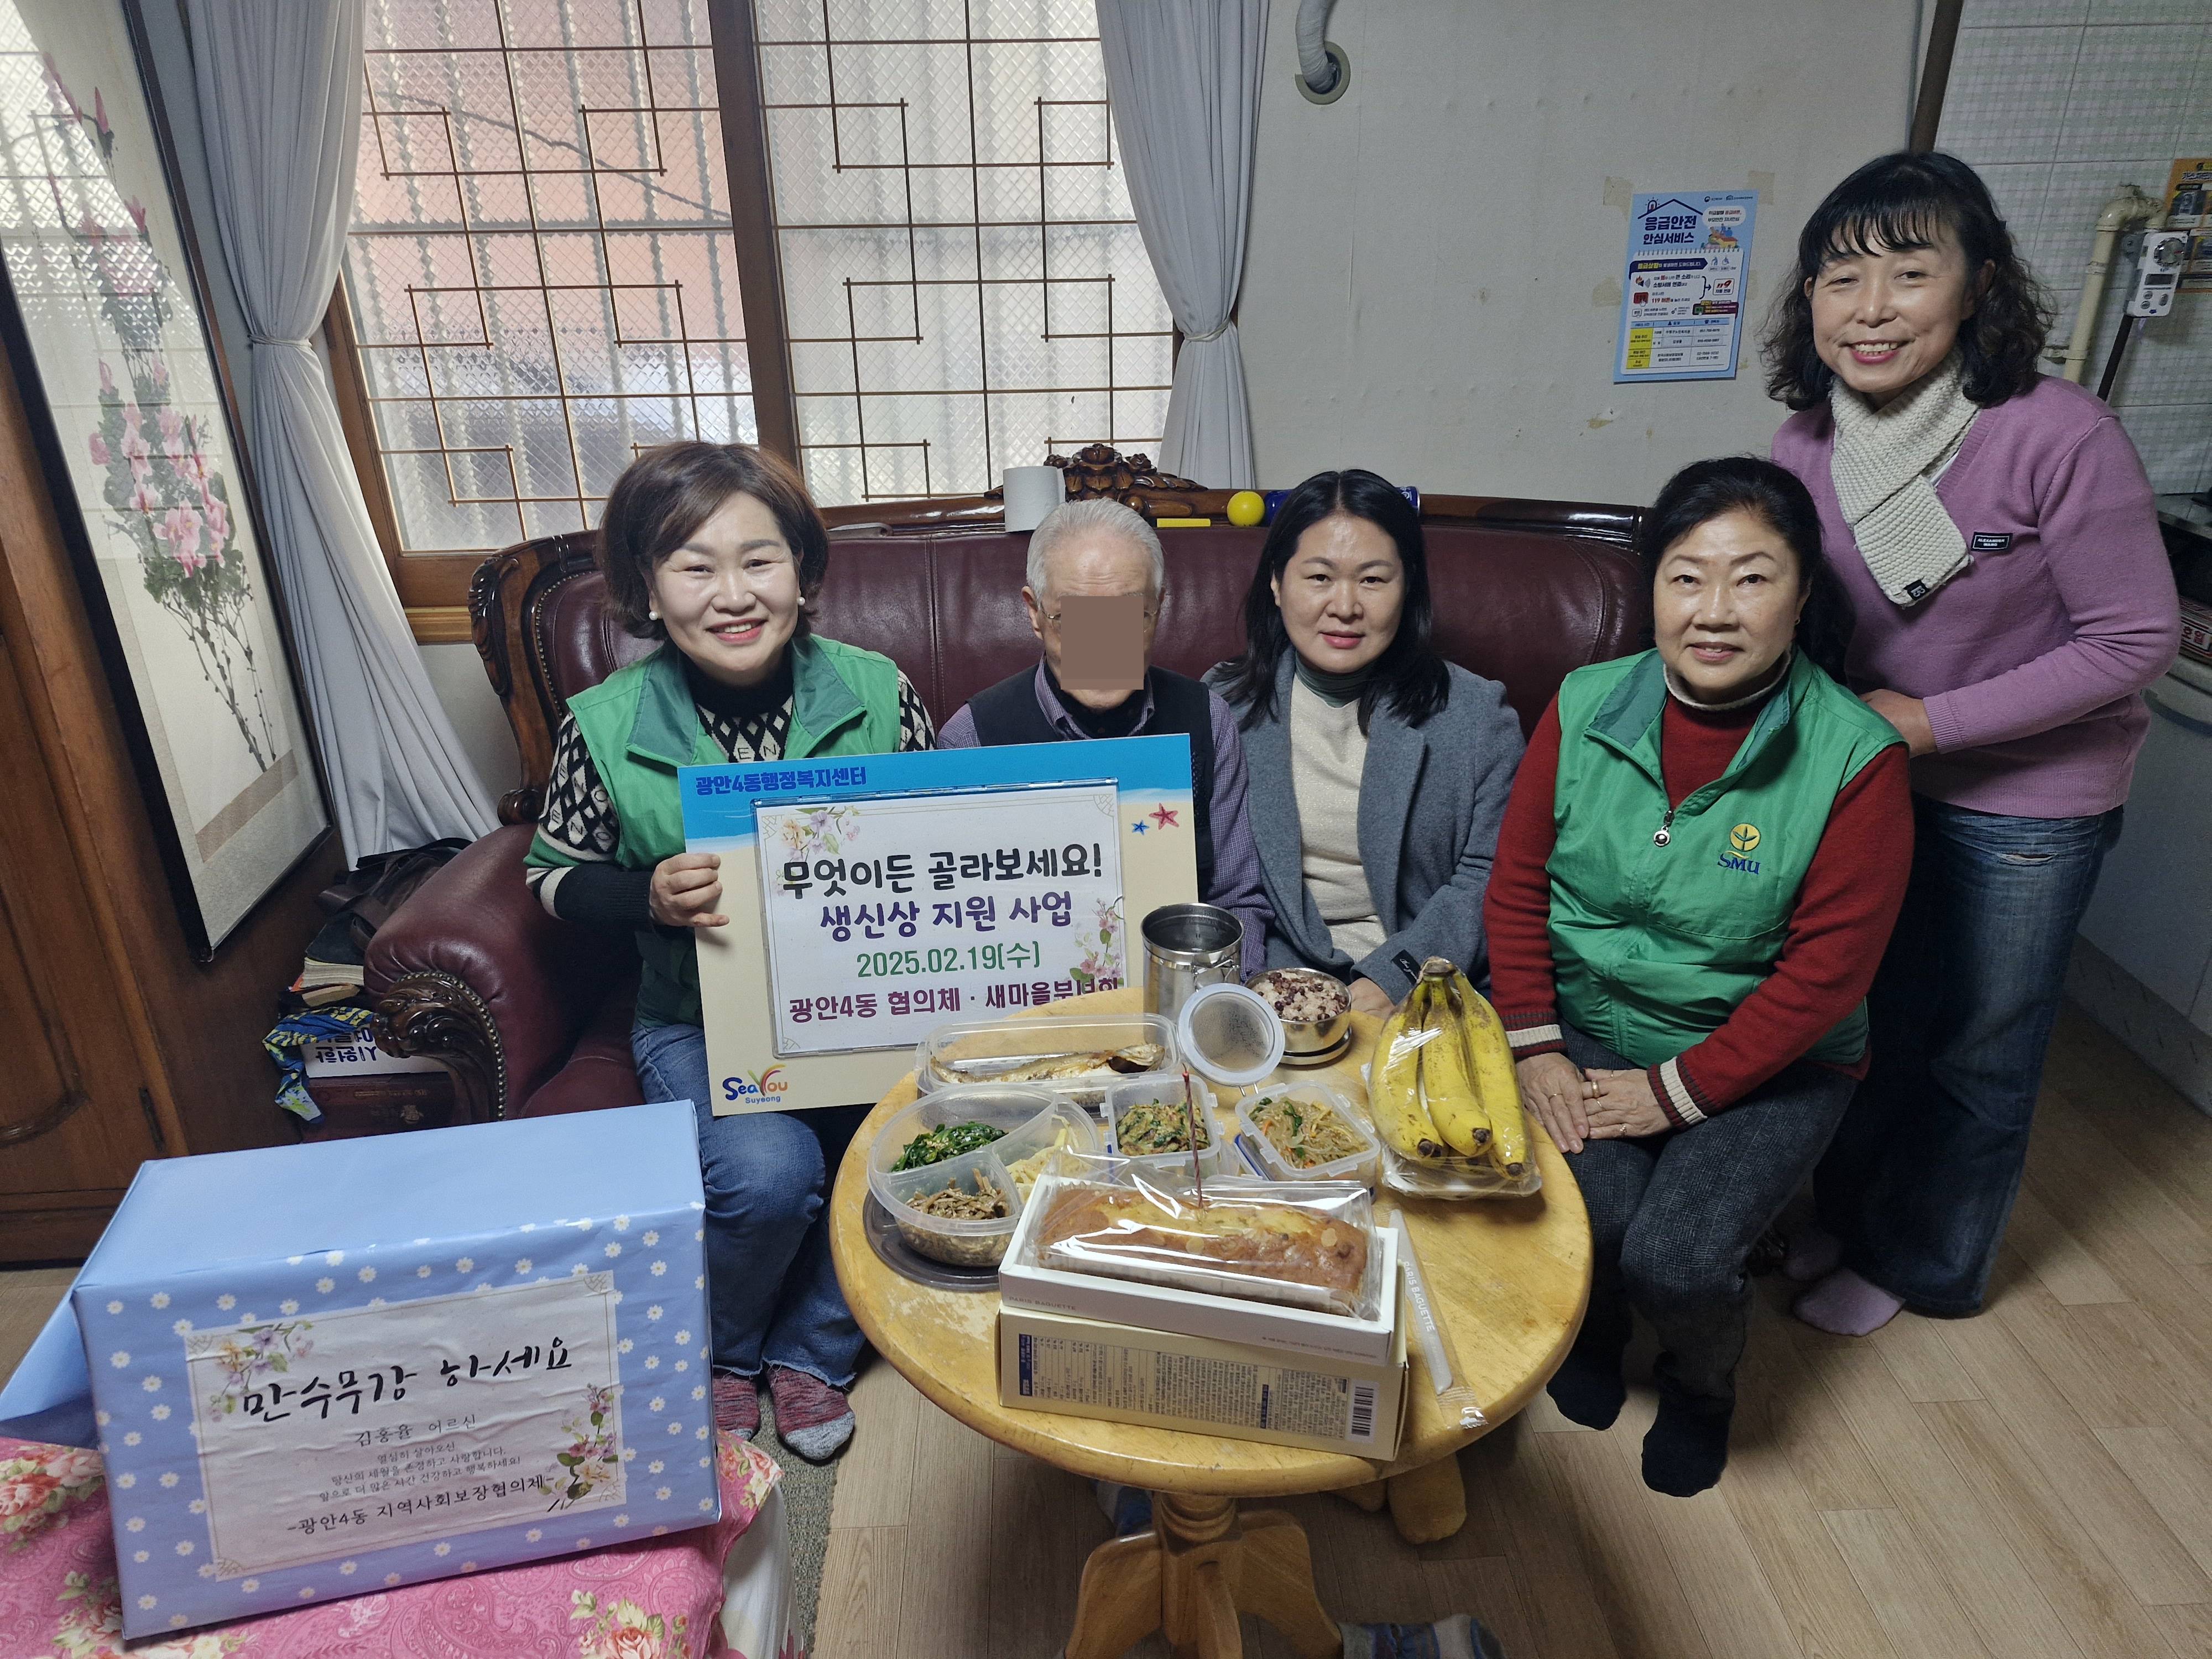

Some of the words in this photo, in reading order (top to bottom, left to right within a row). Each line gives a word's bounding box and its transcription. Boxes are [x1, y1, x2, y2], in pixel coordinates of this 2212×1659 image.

[1644, 215, 1697, 231] 응급안전
[1642, 231, 1694, 245] 안심서비스
[696, 766, 867, 796] 광안4동행정복지센터
[783, 853, 916, 899] 무엇이든
[928, 843, 1102, 890] 골라보세요!
[1717, 853, 1761, 875] SMU
[820, 900, 920, 942] 생신상
[932, 895, 997, 932] 지원
[1009, 890, 1072, 927] 사업
[789, 993, 878, 1023] 광안4동
[888, 988, 961, 1015] 협의체
[315, 1046, 377, 1063] 시원한
[745, 1096, 781, 1104] Suyeong
[1403, 1261, 1417, 1285] PARIS
[1411, 1286, 1436, 1332] BAGUETTE
[243, 1365, 418, 1422] 만수무강
[440, 1337, 572, 1387] 하세요
[429, 1413, 475, 1433] 어르신
[332, 1470, 364, 1486] 당신의
[369, 1465, 400, 1478] 세월을
[450, 1446, 506, 1463] 사랑합니다.
[378, 1451, 409, 1464] 열심히
[415, 1442, 456, 1457] 살아오신
[356, 1484, 366, 1494] 더
[420, 1469, 462, 1484] 건강하고
[466, 1457, 520, 1475] 행복하세요!
[287, 1507, 368, 1535] -광안4동
